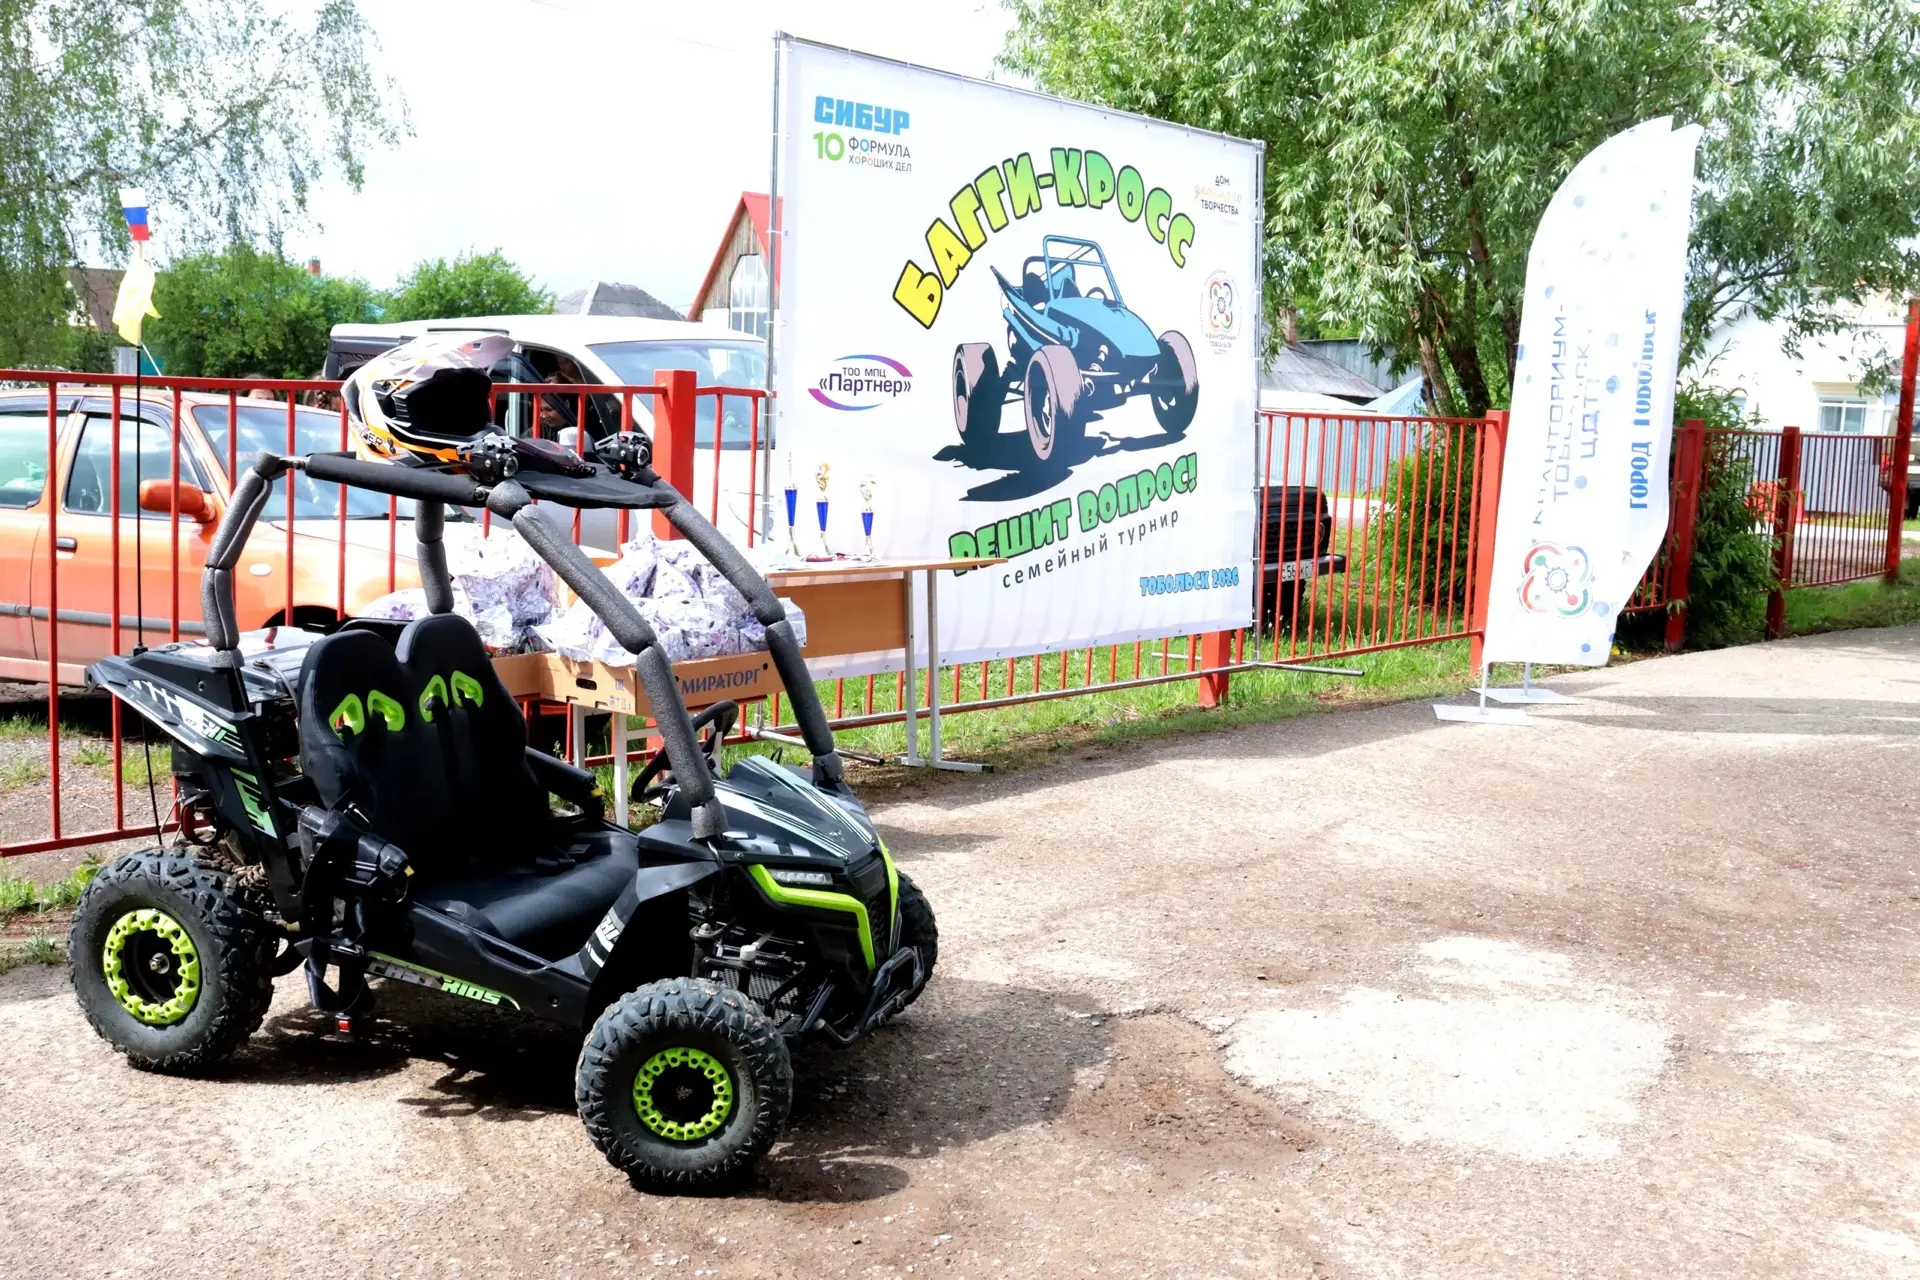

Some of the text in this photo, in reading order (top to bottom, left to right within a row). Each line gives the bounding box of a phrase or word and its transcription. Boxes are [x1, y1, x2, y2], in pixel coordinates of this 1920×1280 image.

[814, 95, 910, 135] СИБУР
[813, 131, 845, 161] 10
[848, 136, 911, 159] ФОРМУЛА
[848, 154, 912, 172] ХОРОШИХ ДЕЛ
[1215, 174, 1230, 186] ДОМ
[1201, 198, 1239, 215] ТВОРЧЕСТВА
[893, 147, 1195, 330] БАГГИ-КРОСС
[819, 373, 911, 397] «Партнер»
[1629, 441, 1652, 509] ГОРОД
[1077, 452, 1198, 533] ВОПРОС!
[1003, 509, 1179, 588] семейный турнир
[1140, 566, 1239, 596] ТОБОЛЬСК 2026
[681, 668, 760, 695] МИРАТОРГ
